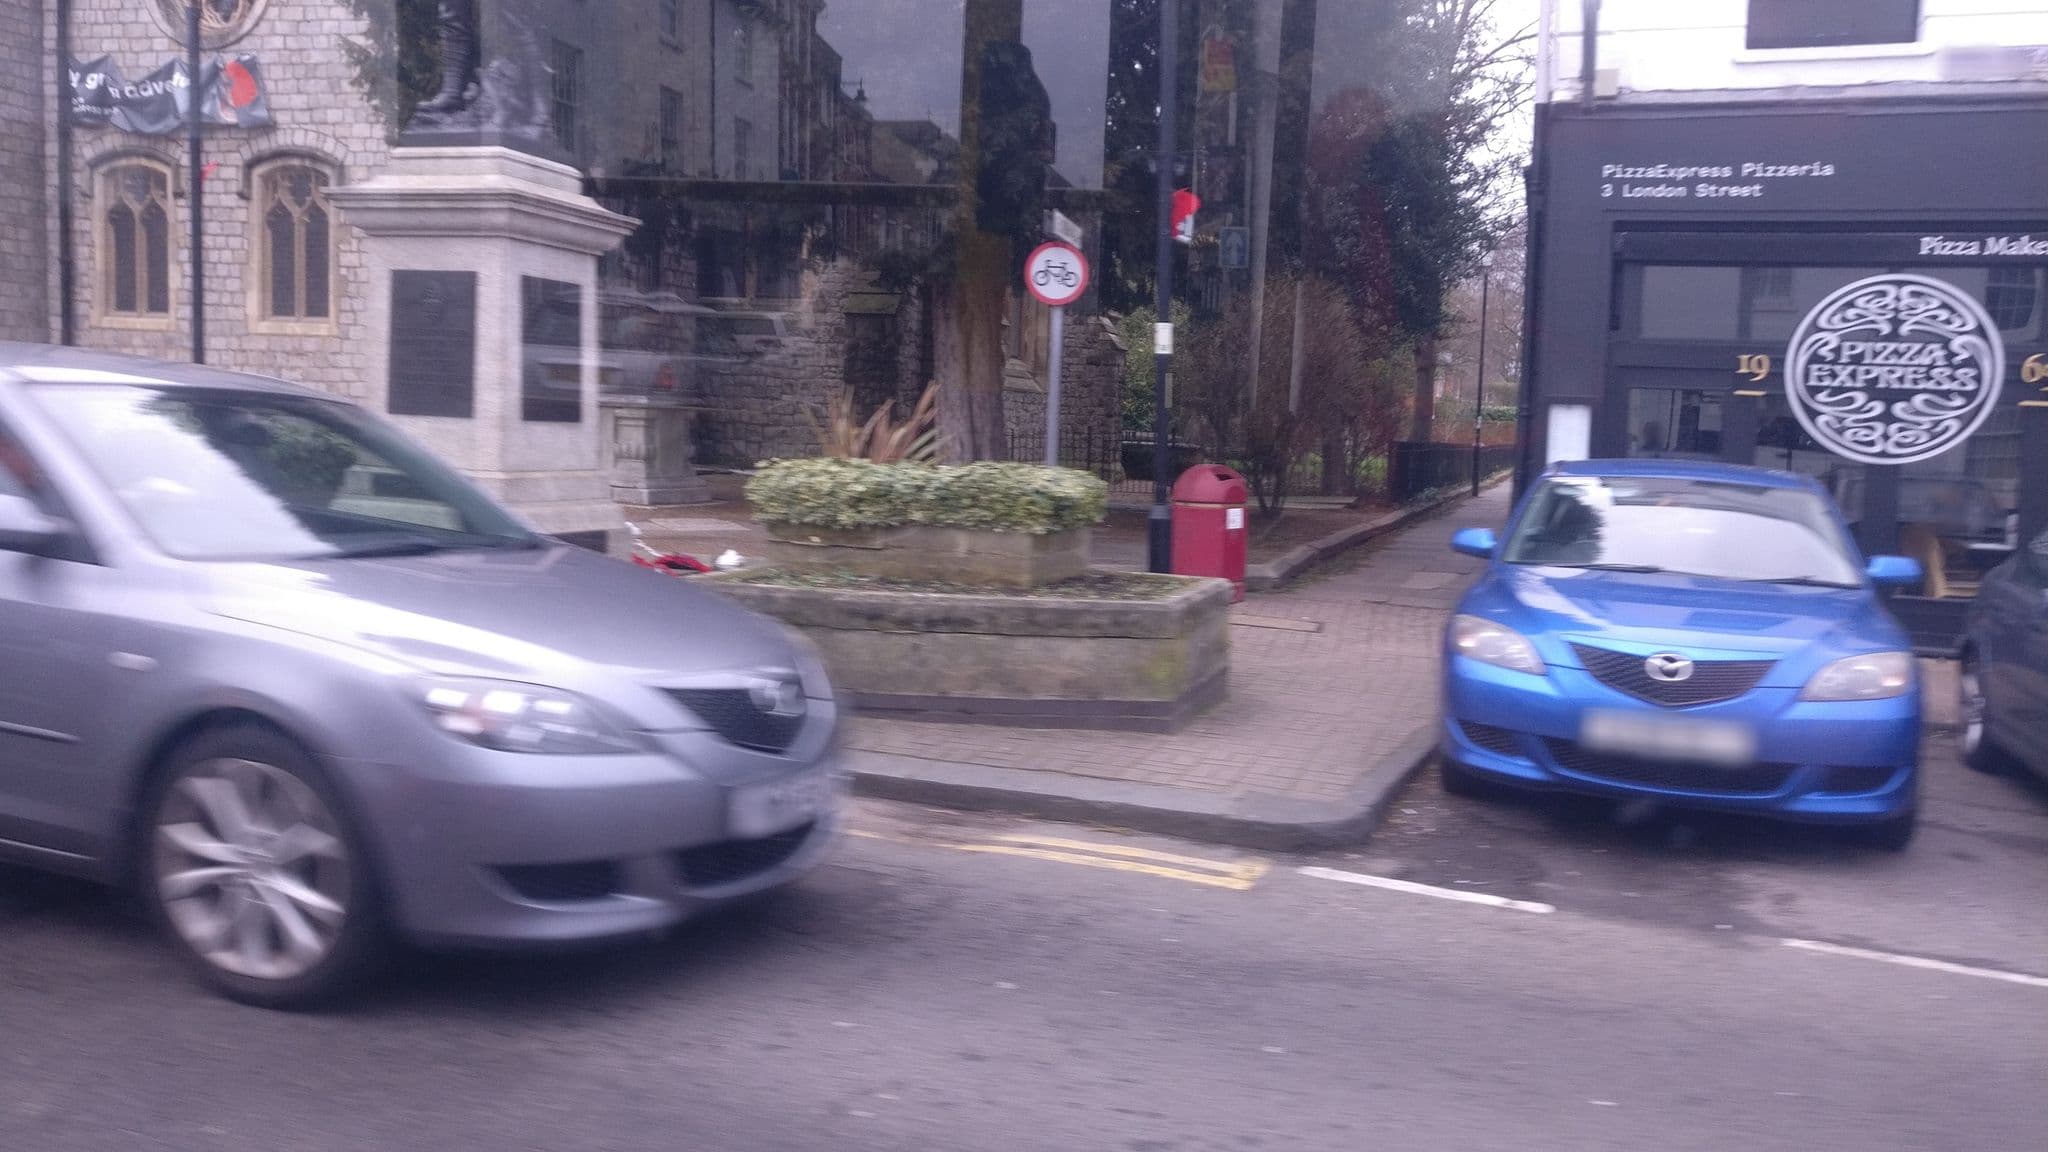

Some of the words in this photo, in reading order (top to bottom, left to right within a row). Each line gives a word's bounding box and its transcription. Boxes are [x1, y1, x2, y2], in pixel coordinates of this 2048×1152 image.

[1601, 164, 1733, 181] PizzaExpress
[1740, 161, 1835, 178] Pizzeria
[1600, 183, 1614, 198] 3
[1621, 183, 1688, 198] London
[1694, 183, 1764, 198] Street
[1918, 235, 1982, 256] Pizza
[1837, 340, 1950, 366] PIZZA
[1734, 353, 1772, 383] 19
[1805, 363, 1980, 392] EXPRESS
